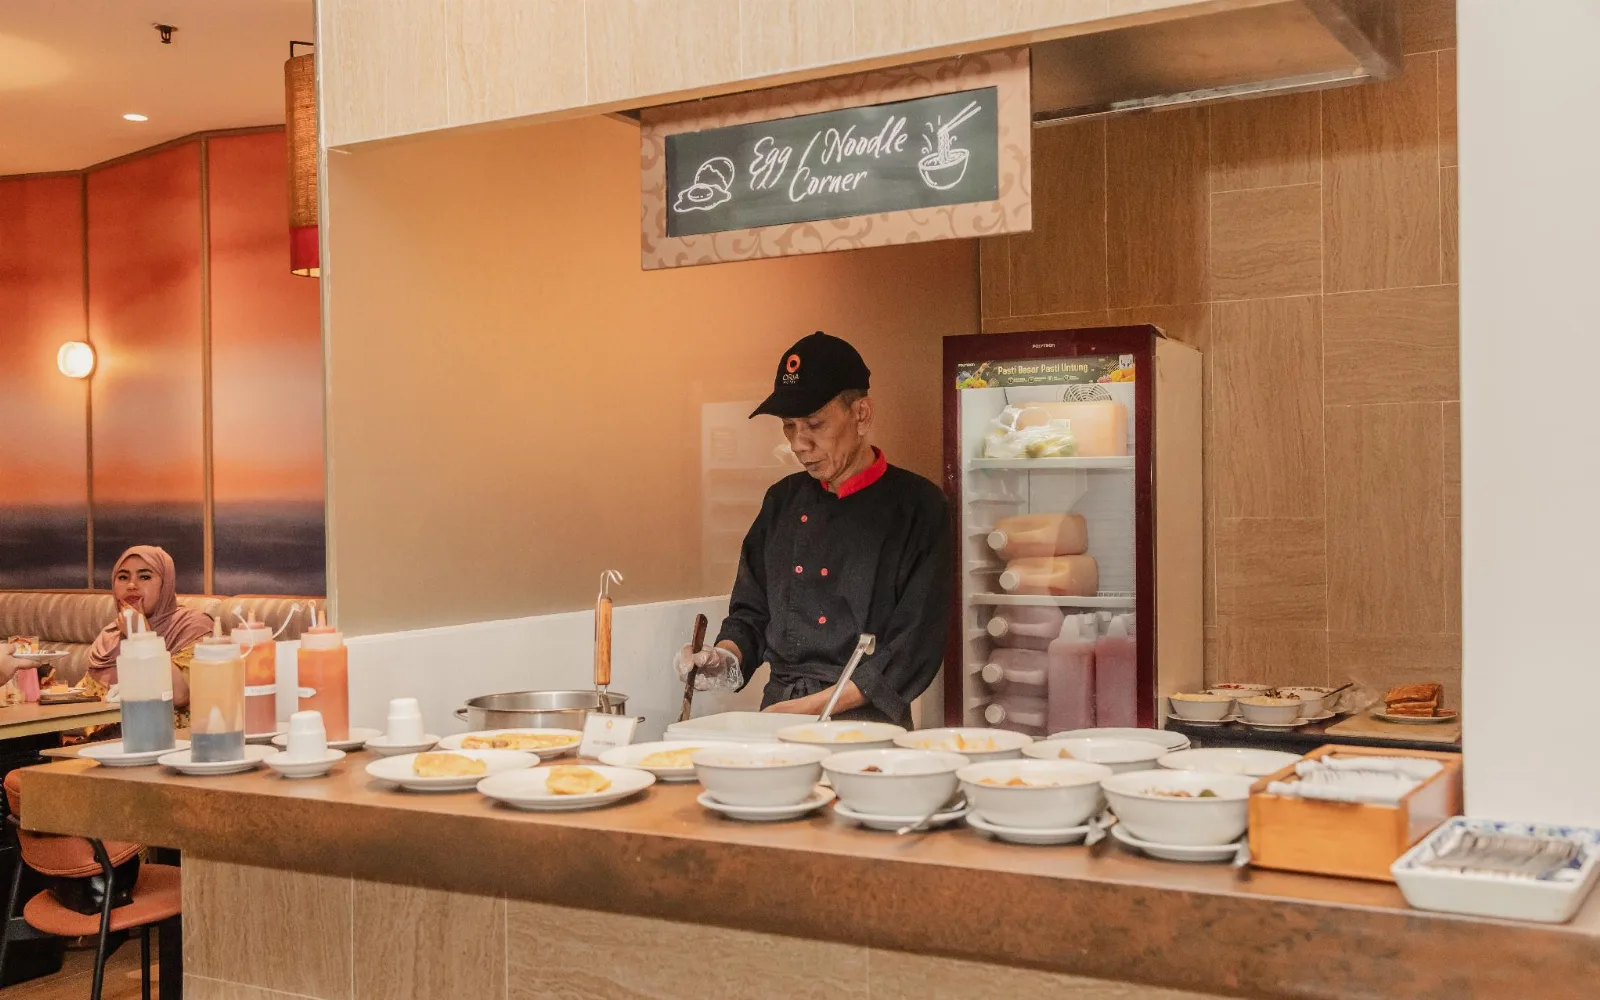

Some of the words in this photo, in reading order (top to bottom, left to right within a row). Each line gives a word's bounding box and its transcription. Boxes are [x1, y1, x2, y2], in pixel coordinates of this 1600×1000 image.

[749, 136, 793, 191] Egg
[821, 115, 908, 165] Noodle
[788, 166, 868, 202] Corner
[997, 366, 1017, 375] Pasti
[1041, 363, 1060, 373] Pasti
[1061, 362, 1088, 373] Untung
